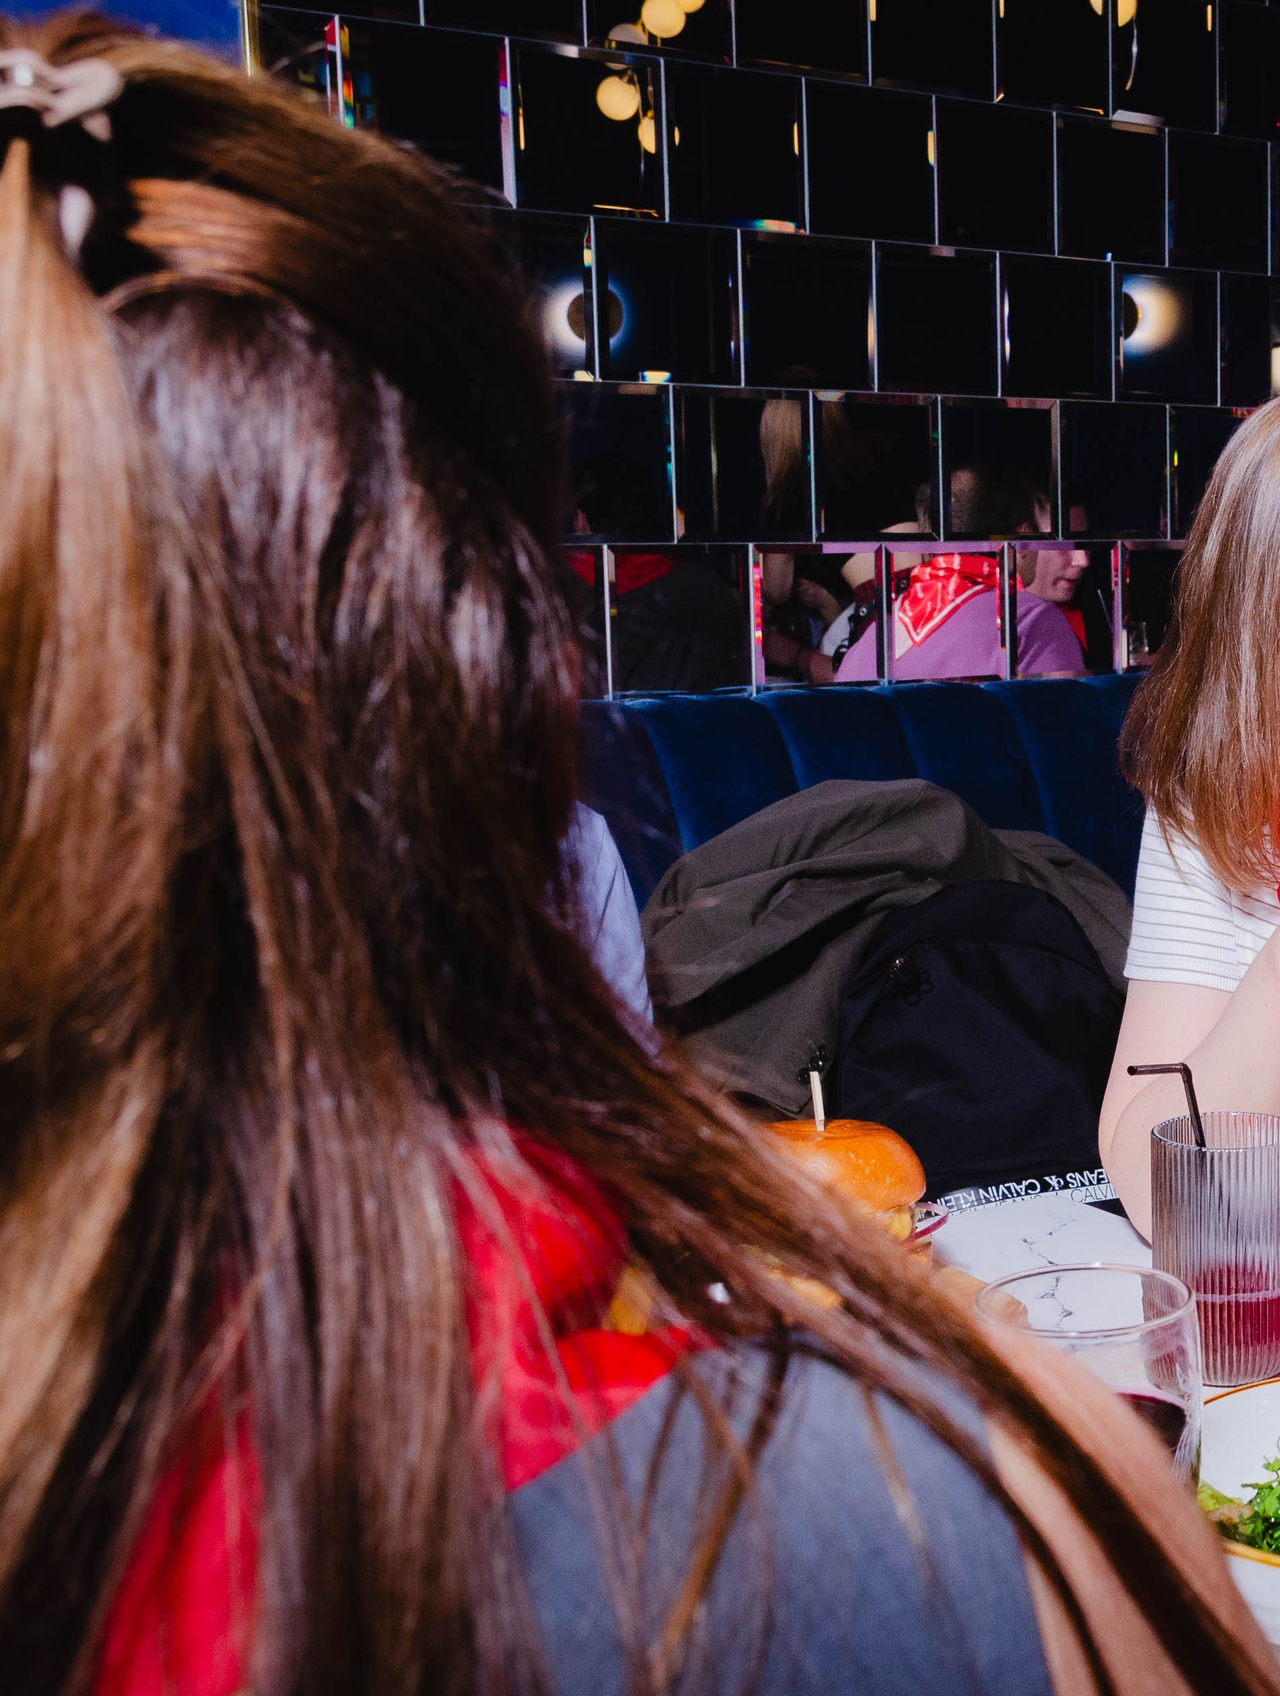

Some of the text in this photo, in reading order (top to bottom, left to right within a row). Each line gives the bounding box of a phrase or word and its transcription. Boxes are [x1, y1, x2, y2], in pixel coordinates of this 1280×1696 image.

[1066, 1168, 1108, 1187] EANS
[978, 1178, 1041, 1204] CALVIN
[1071, 1184, 1116, 1204] CALVI
